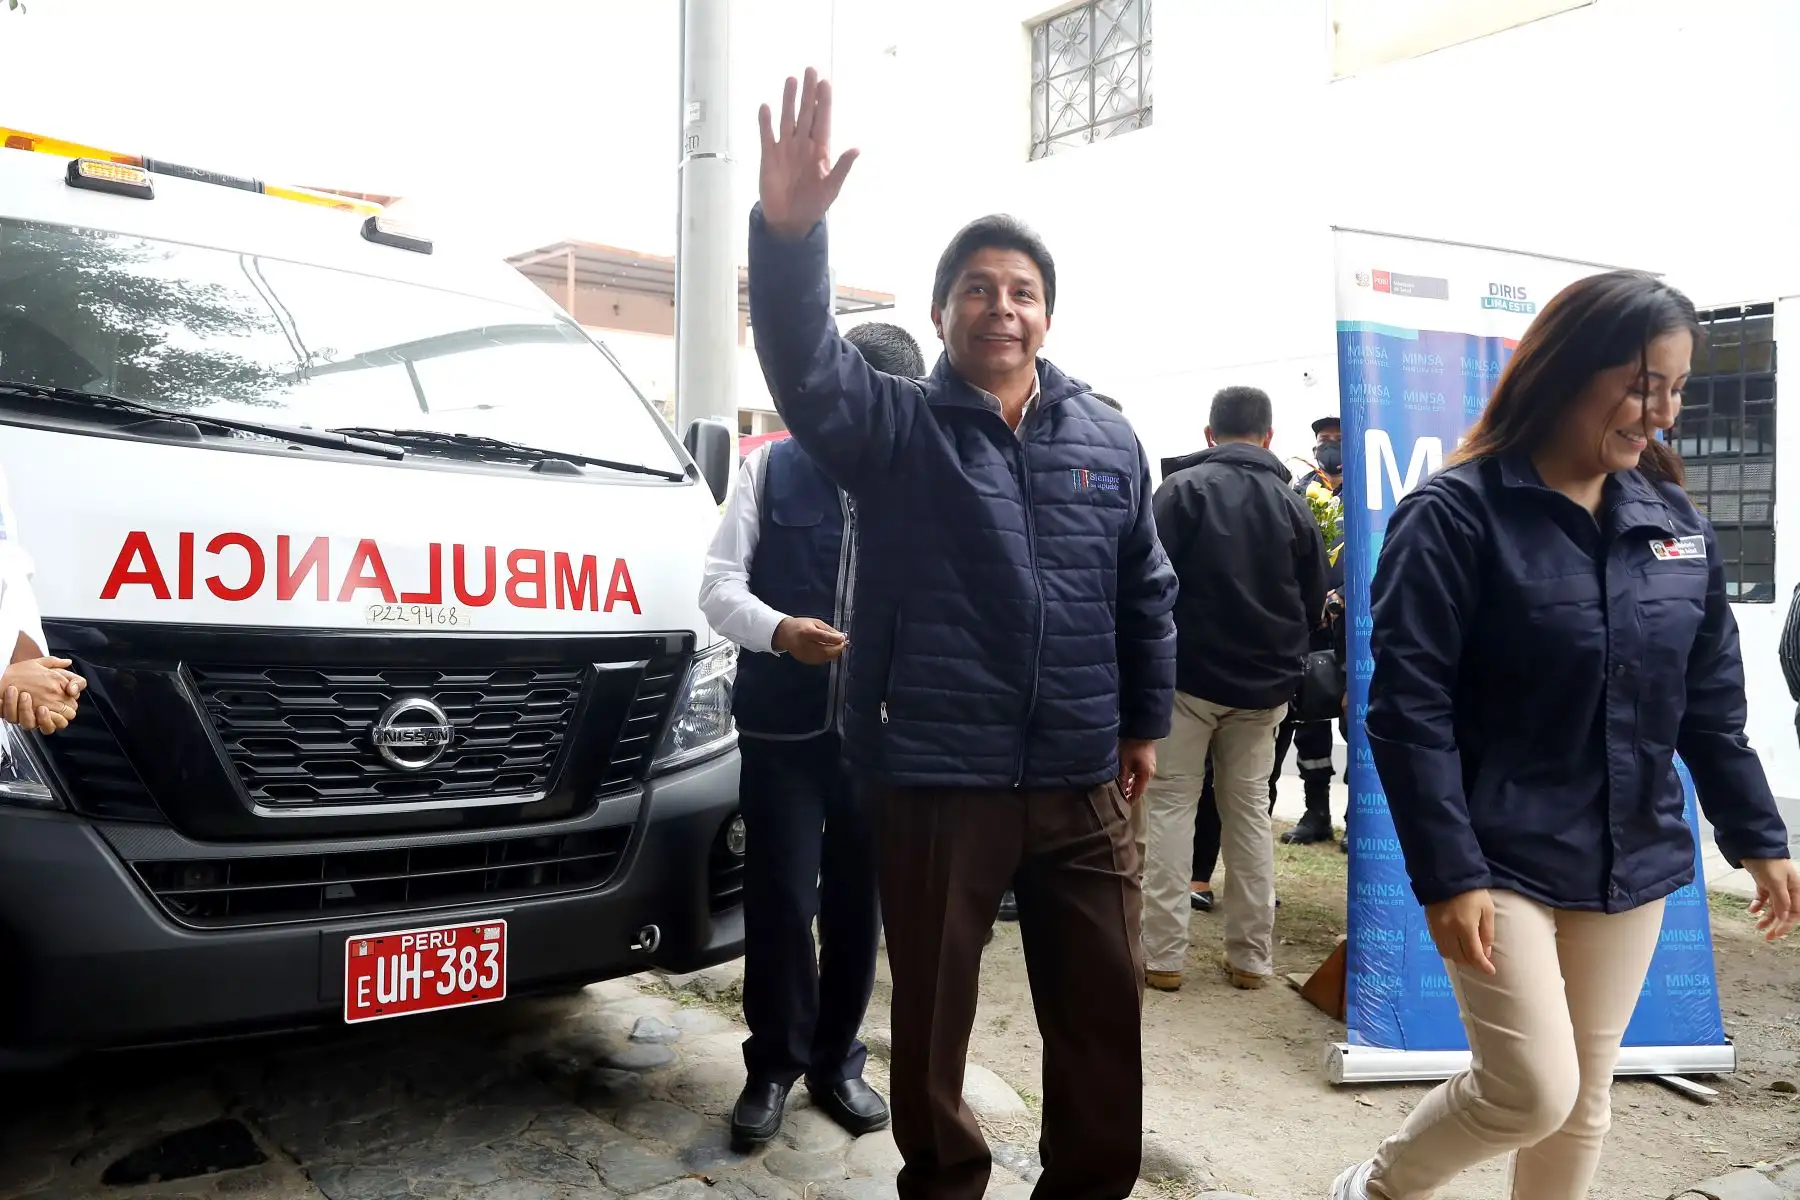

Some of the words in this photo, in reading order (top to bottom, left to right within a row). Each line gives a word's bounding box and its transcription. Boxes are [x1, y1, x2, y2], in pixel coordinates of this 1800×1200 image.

[1489, 282, 1527, 300] DIRIS
[1508, 301, 1533, 312] ESTE
[1347, 346, 1388, 359] MINSA
[1402, 351, 1443, 366] MINSA
[1460, 357, 1500, 372] MINSA
[1349, 384, 1390, 398] MINSA
[1404, 390, 1446, 404] MINSA
[1463, 395, 1487, 409] MIN
[369, 605, 458, 625] P229468
[383, 729, 449, 743] NISSAN
[1357, 793, 1386, 805] MIN
[1357, 883, 1404, 897] MINSA
[1668, 885, 1700, 898] NSA
[401, 930, 457, 952] PERU
[1661, 930, 1705, 942] MINSA
[1666, 974, 1710, 987] MINSA
